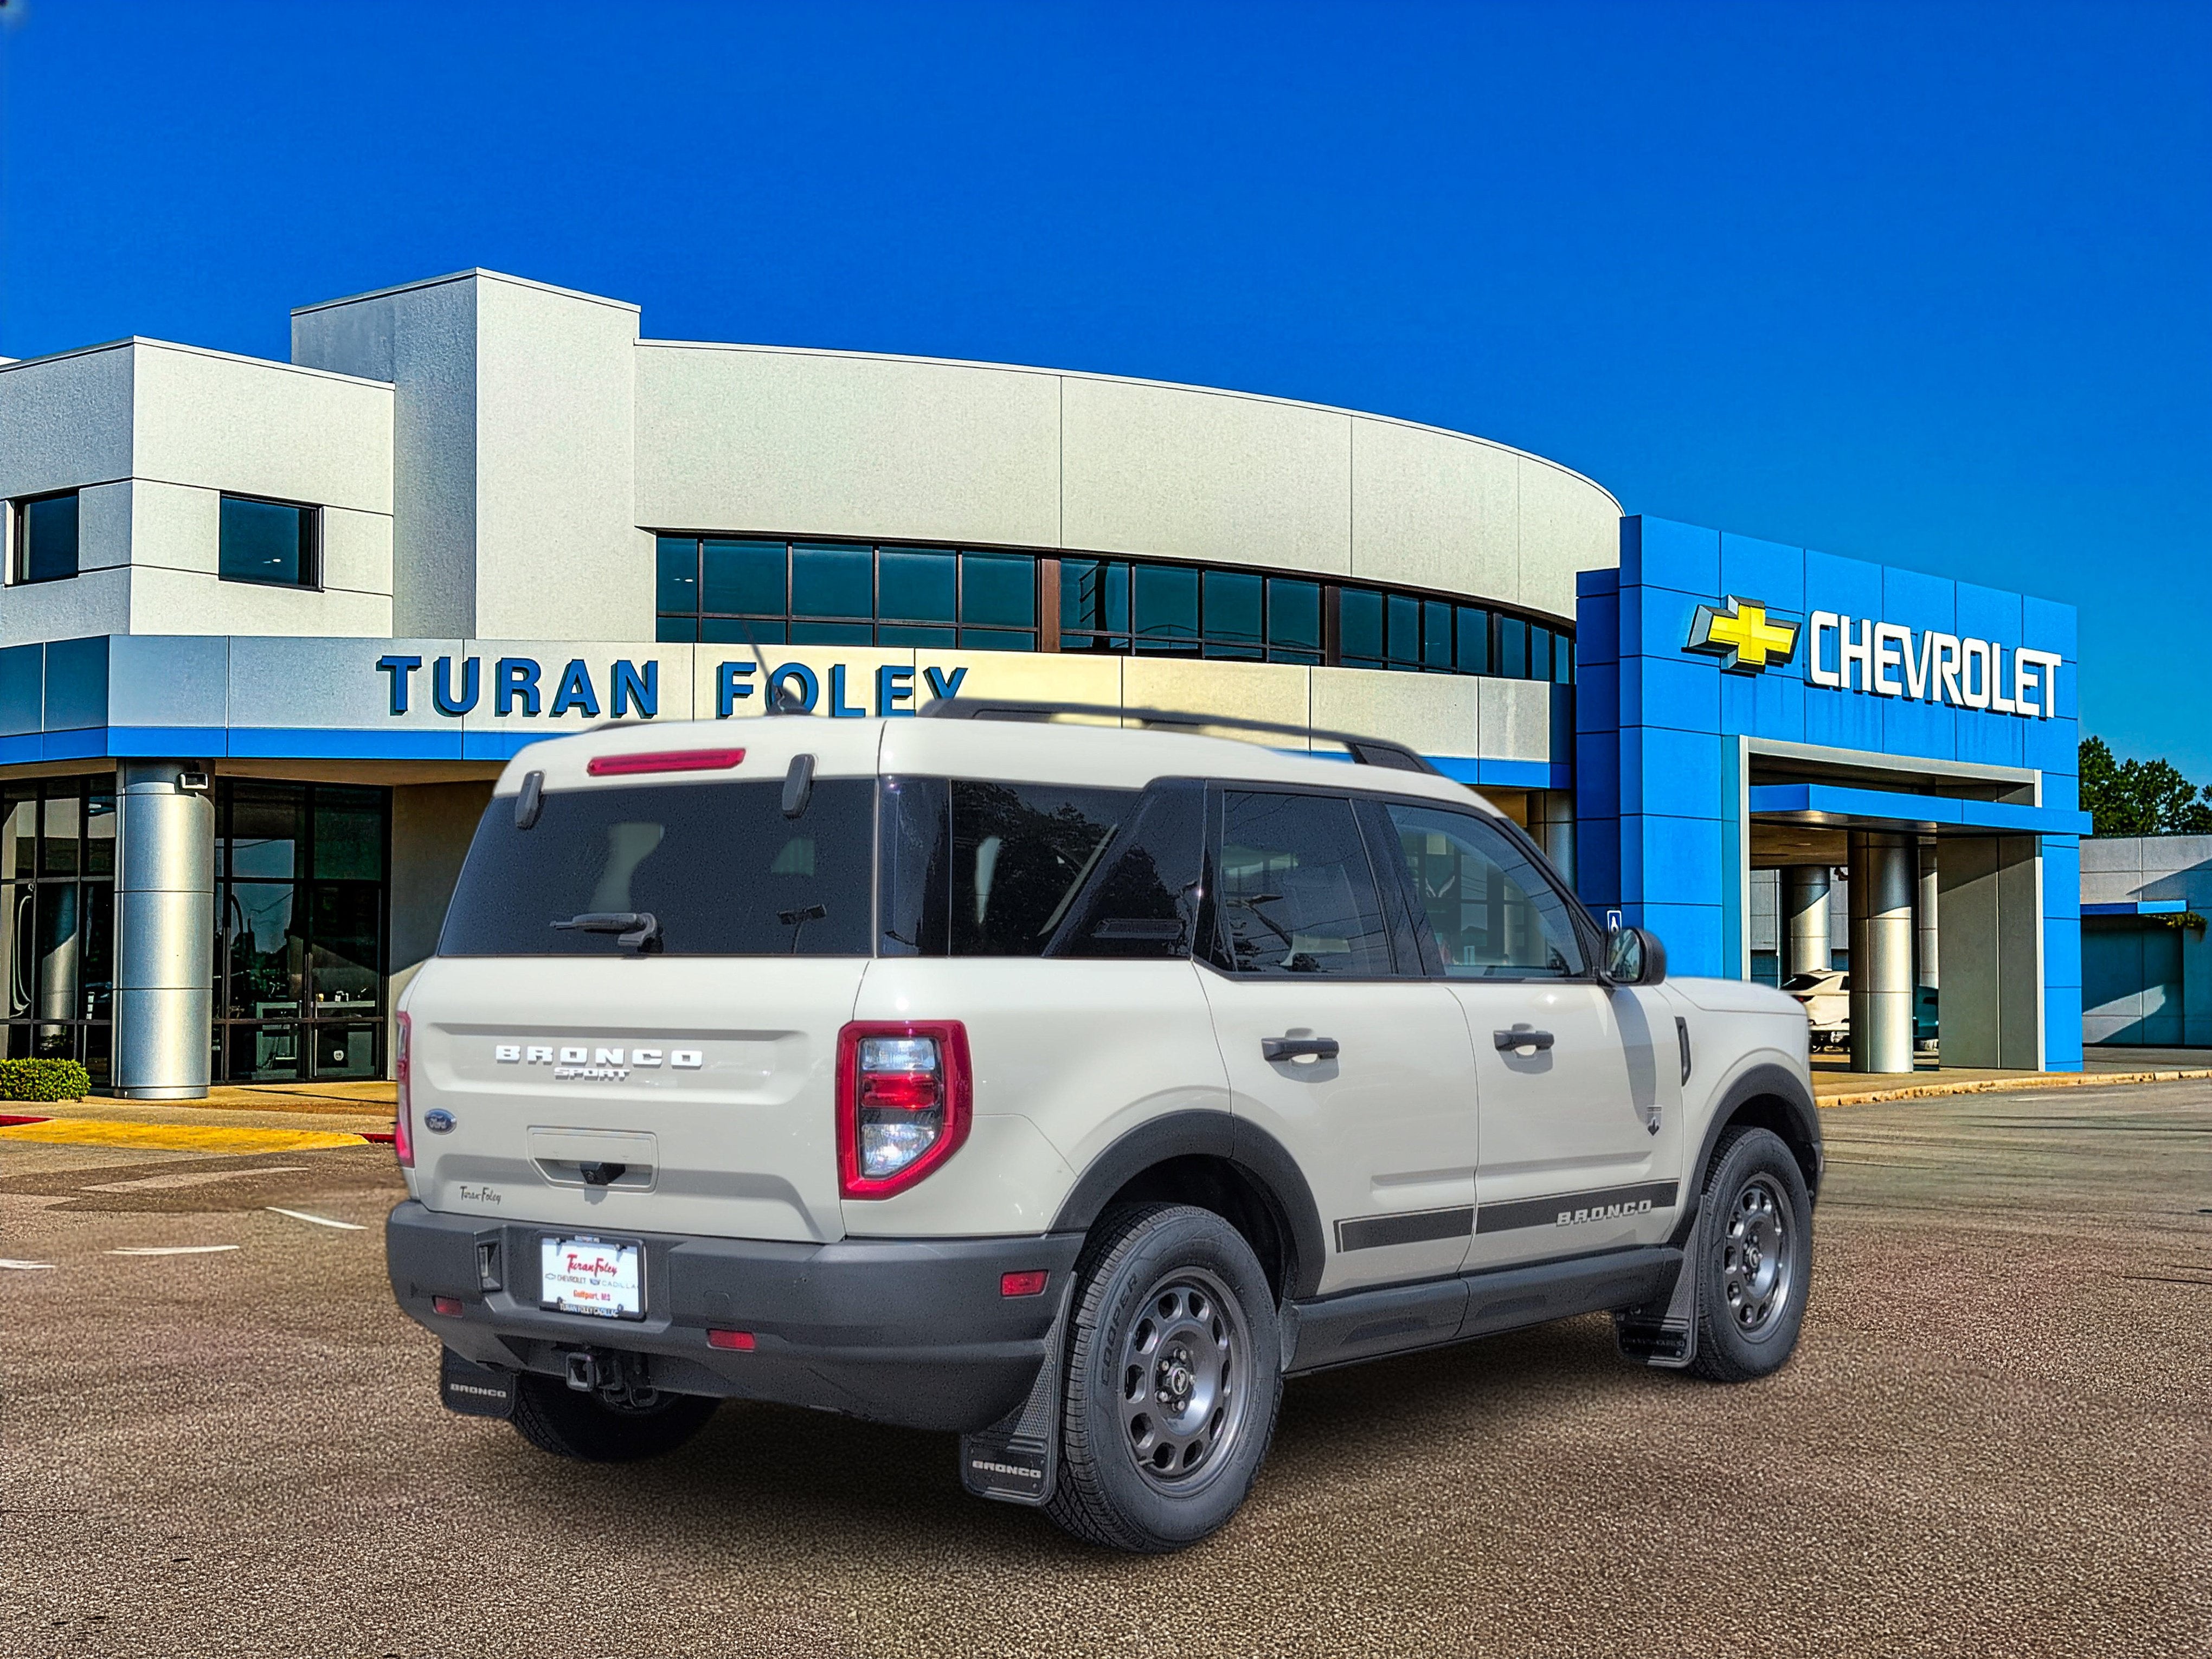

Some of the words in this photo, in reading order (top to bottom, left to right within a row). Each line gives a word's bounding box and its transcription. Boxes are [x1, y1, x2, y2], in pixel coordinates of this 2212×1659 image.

[1810, 609, 2062, 720] CHEVROLET
[376, 655, 659, 719] TURAN
[716, 661, 969, 719] FOLEY
[496, 1045, 703, 1070] BRONCO
[554, 1067, 631, 1081] SPORT
[1555, 1199, 1652, 1227] BRONCO
[567, 1253, 594, 1274] Turan
[594, 1257, 617, 1277] Foley
[602, 1280, 639, 1290] CADILLA
[1101, 1273, 1137, 1386] COOPER
[450, 1383, 506, 1398] BRONCO
[972, 1460, 1041, 1479] BRONCO
